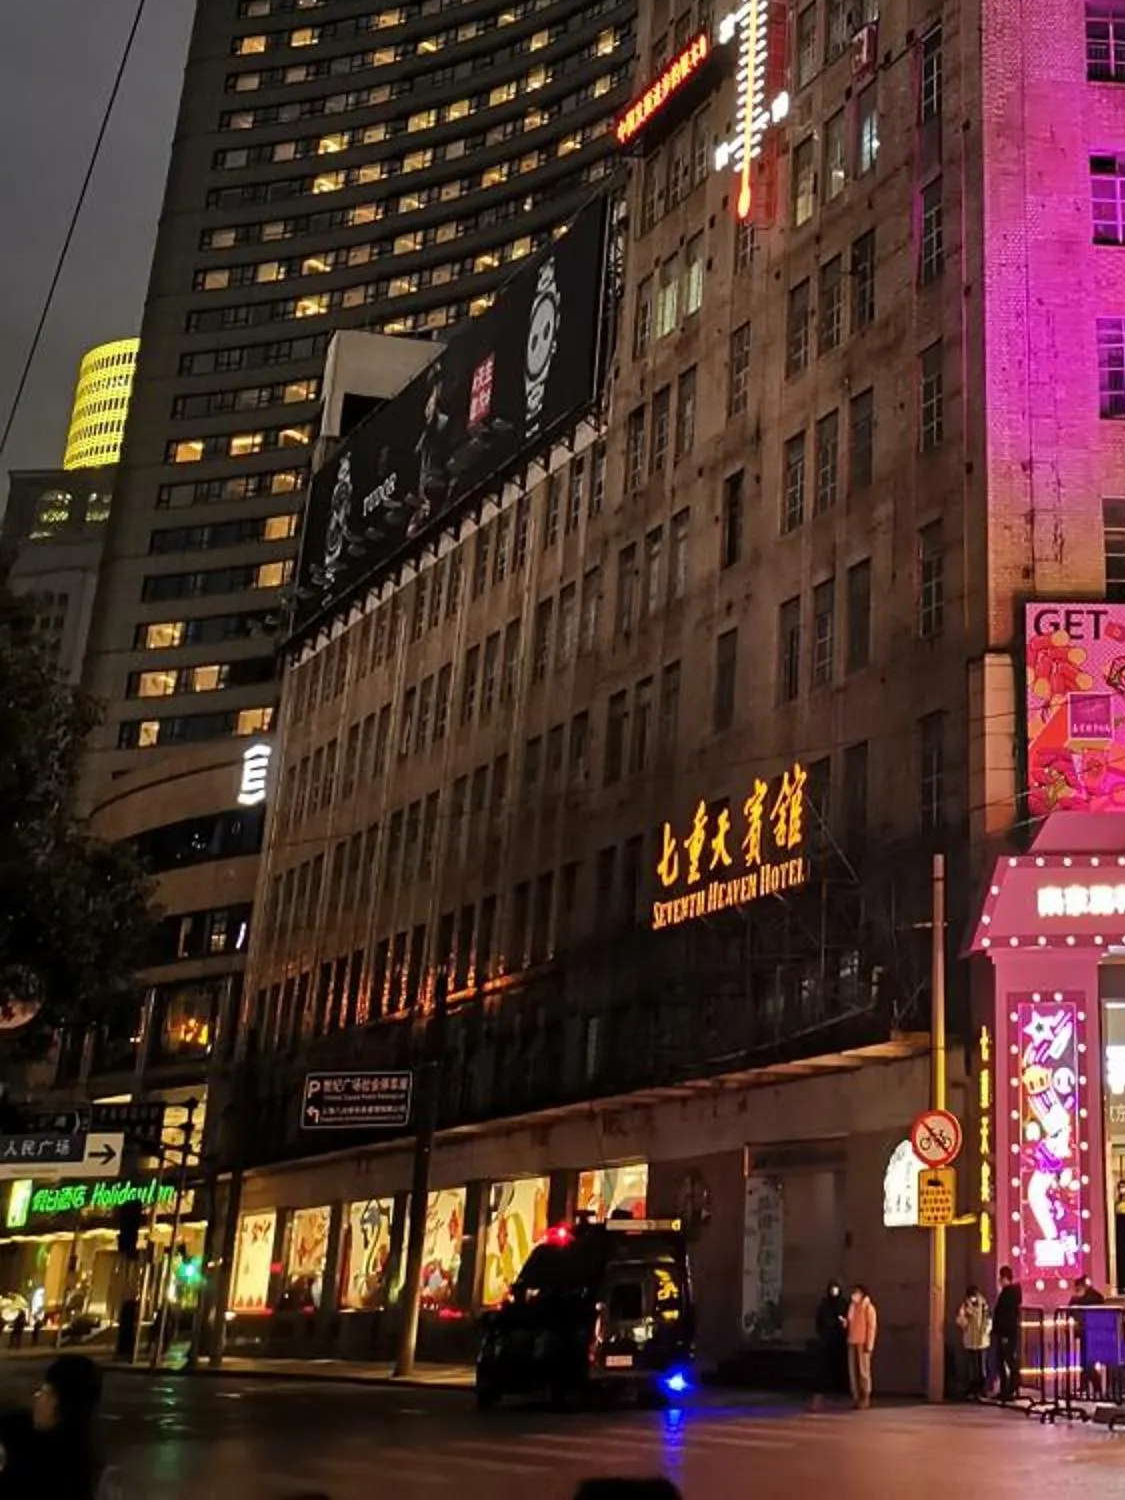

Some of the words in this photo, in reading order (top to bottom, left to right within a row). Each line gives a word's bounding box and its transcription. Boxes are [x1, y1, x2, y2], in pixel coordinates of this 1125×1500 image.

[1033, 610, 1108, 641] GET
[3, 1139, 71, 1156] 人民广场
[90, 1179, 149, 1206] Holiday
